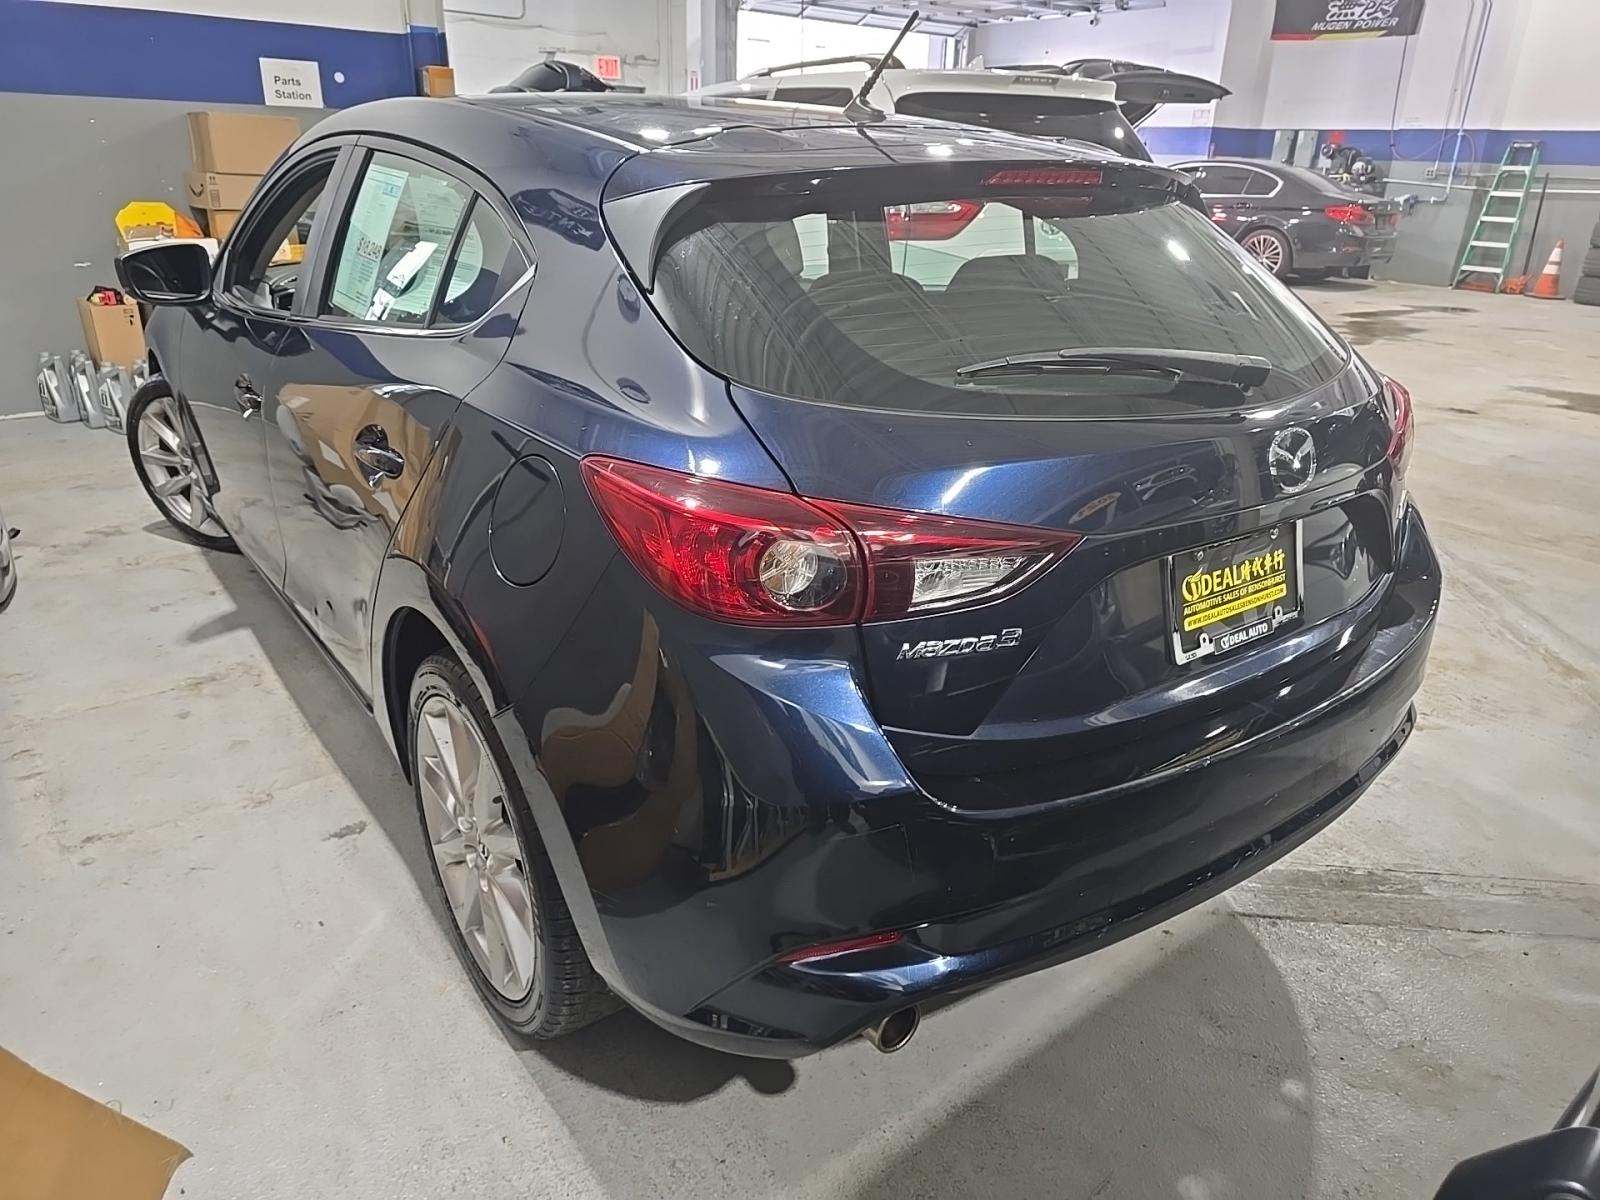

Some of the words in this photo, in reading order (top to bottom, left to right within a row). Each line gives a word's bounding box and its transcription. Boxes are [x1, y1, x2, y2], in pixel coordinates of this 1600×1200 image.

[1311, 20, 1351, 31] MUGEN
[1353, 17, 1399, 29] POWER
[598, 59, 618, 77] EXIT
[274, 75, 301, 86] Parts
[275, 89, 312, 101] Station
[1183, 596, 1222, 616] AUTOMOTIVE
[1222, 589, 1239, 603] SALES
[1240, 585, 1248, 597] OF
[1248, 624, 1268, 638] AUTO
